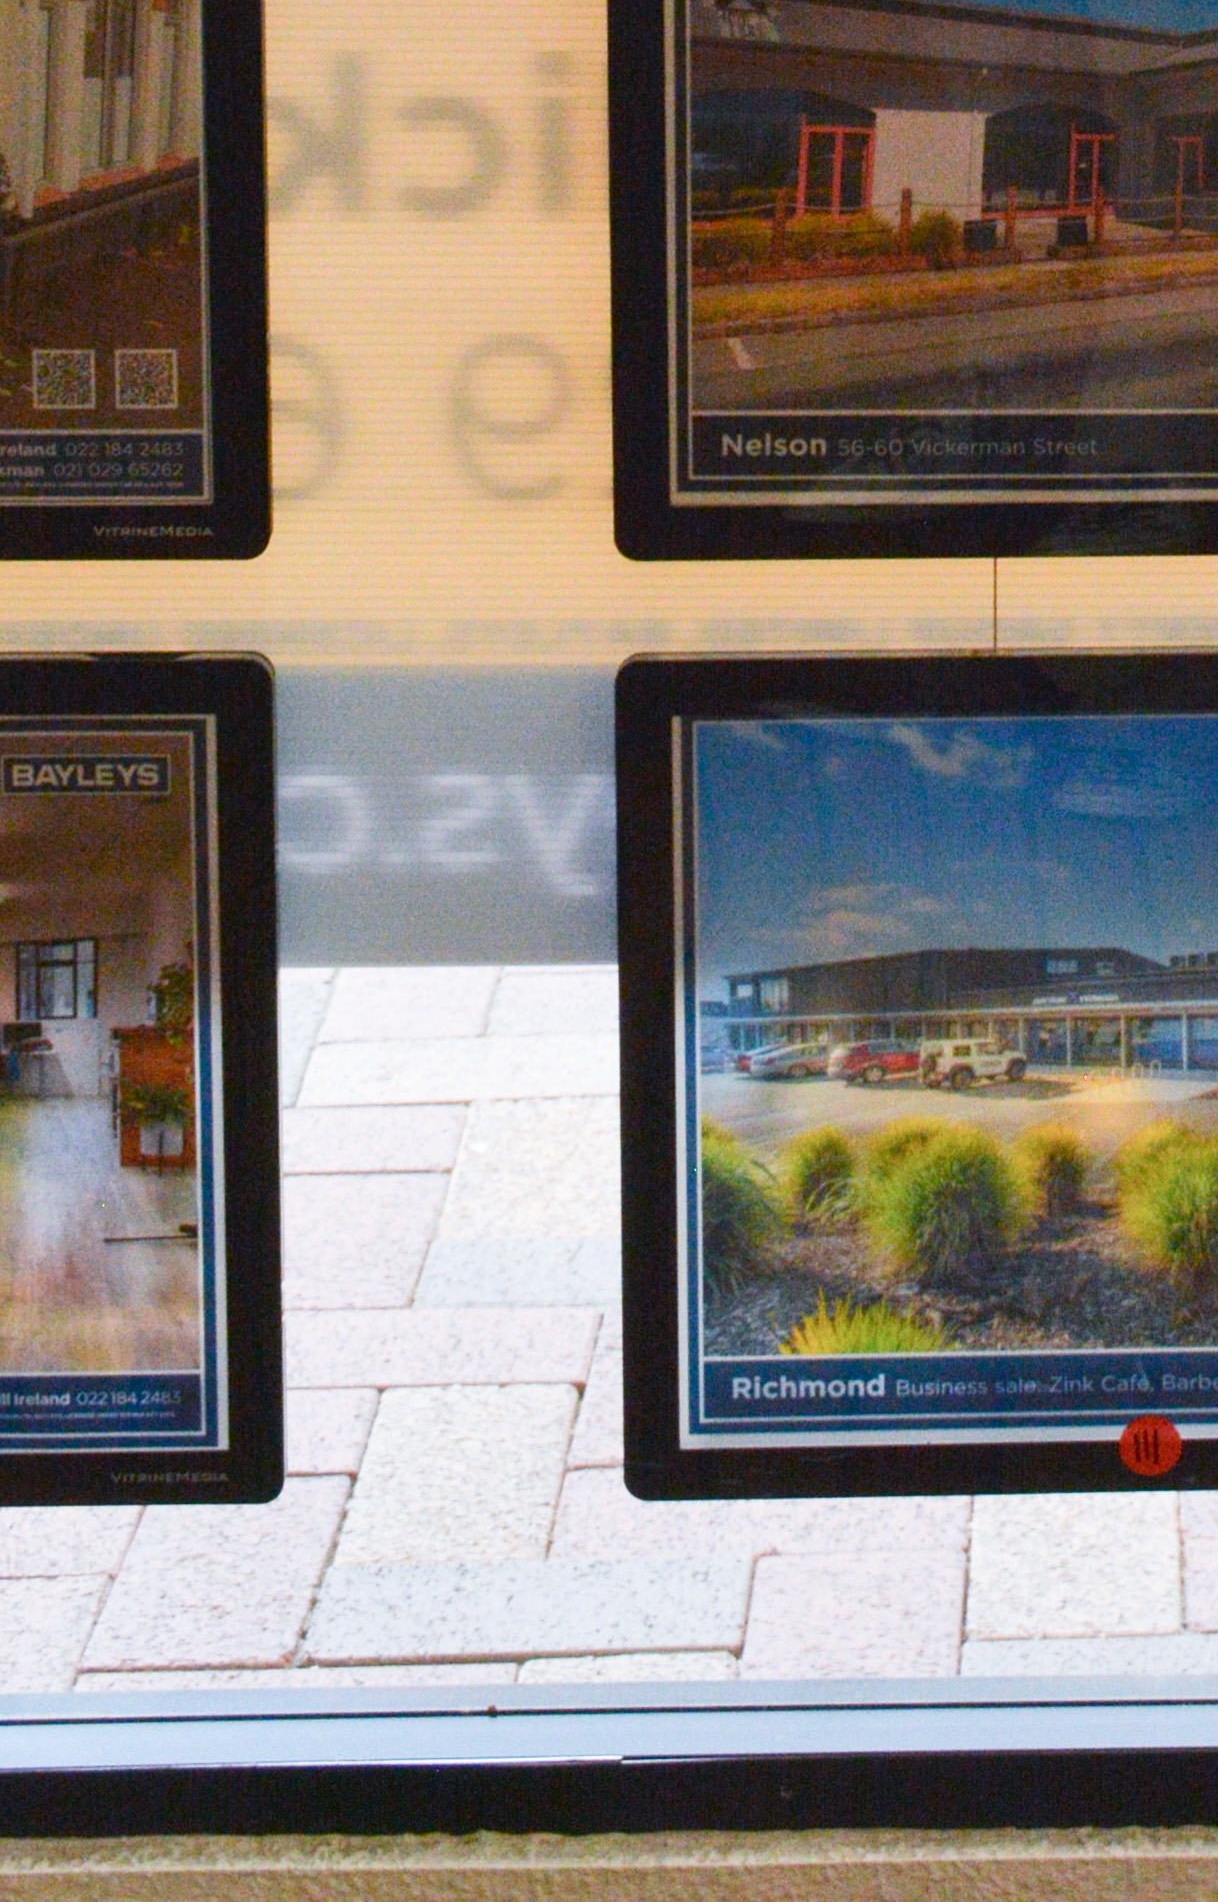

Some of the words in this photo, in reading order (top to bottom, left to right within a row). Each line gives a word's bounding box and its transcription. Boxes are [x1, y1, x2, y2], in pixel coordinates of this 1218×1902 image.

[720, 433, 827, 457] Nelson
[838, 437, 902, 457] 56-60
[911, 436, 1025, 457] Vickerman
[1033, 436, 1098, 457] Street
[12, 763, 160, 787] BAYLEYS
[731, 1373, 886, 1399] Richmond
[896, 1379, 987, 1397] Business
[1050, 1374, 1093, 1393] Zink
[14, 1392, 71, 1406] Ireland
[76, 1391, 107, 1405] 022
[111, 1391, 138, 1405] 184
[140, 1391, 181, 1405] 2483
